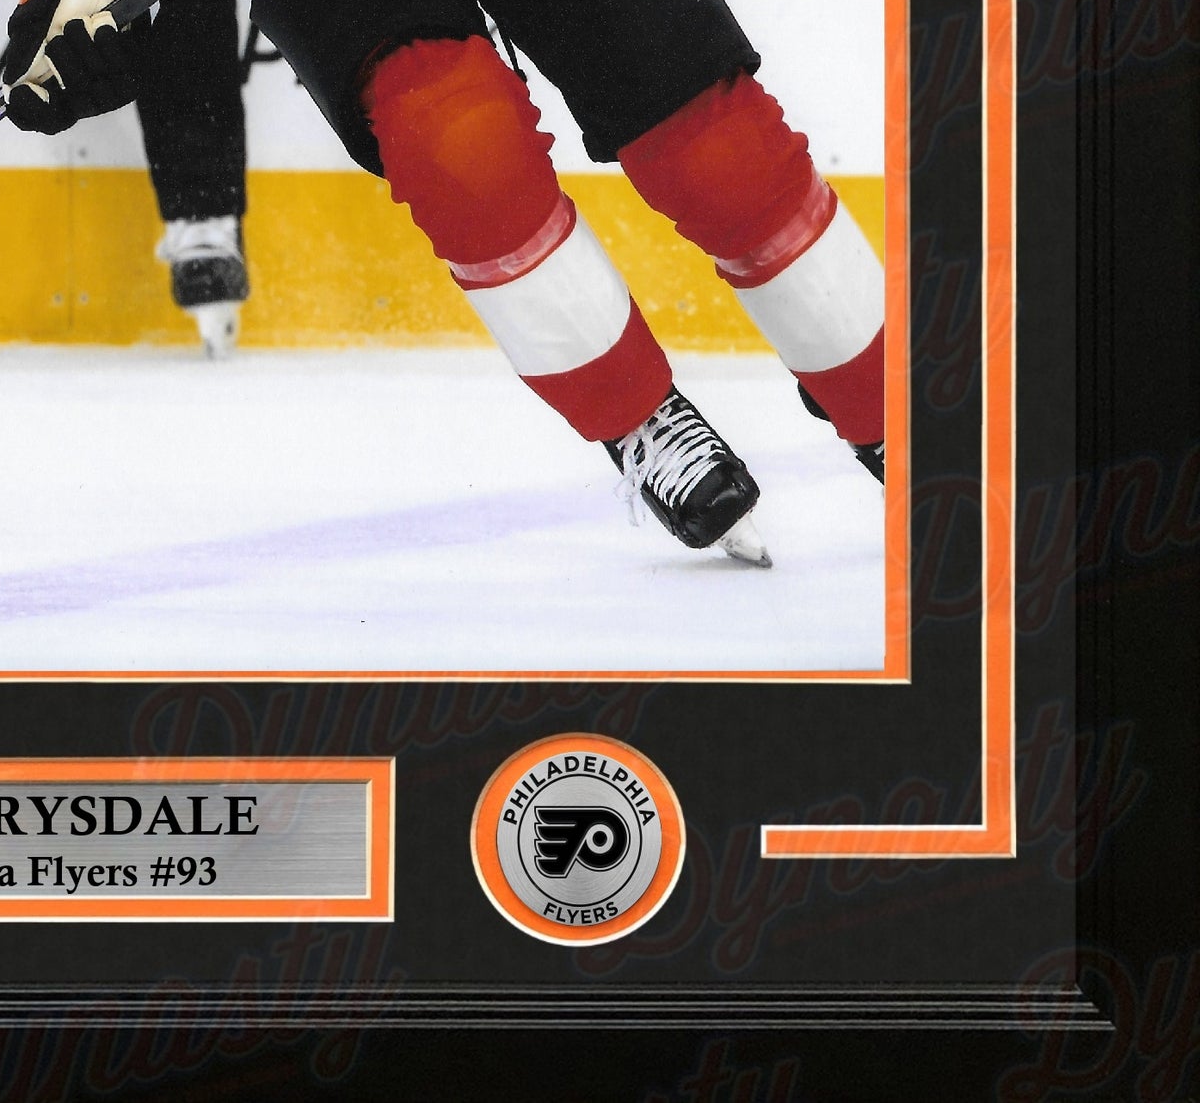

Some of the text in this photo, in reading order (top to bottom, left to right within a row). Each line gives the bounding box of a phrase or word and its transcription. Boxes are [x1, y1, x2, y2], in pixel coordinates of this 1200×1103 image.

[502, 755, 656, 826] PHILADELPHIA
[28, 855, 138, 895] Flyers
[149, 855, 218, 888] #93
[543, 901, 619, 925] FLYERS
